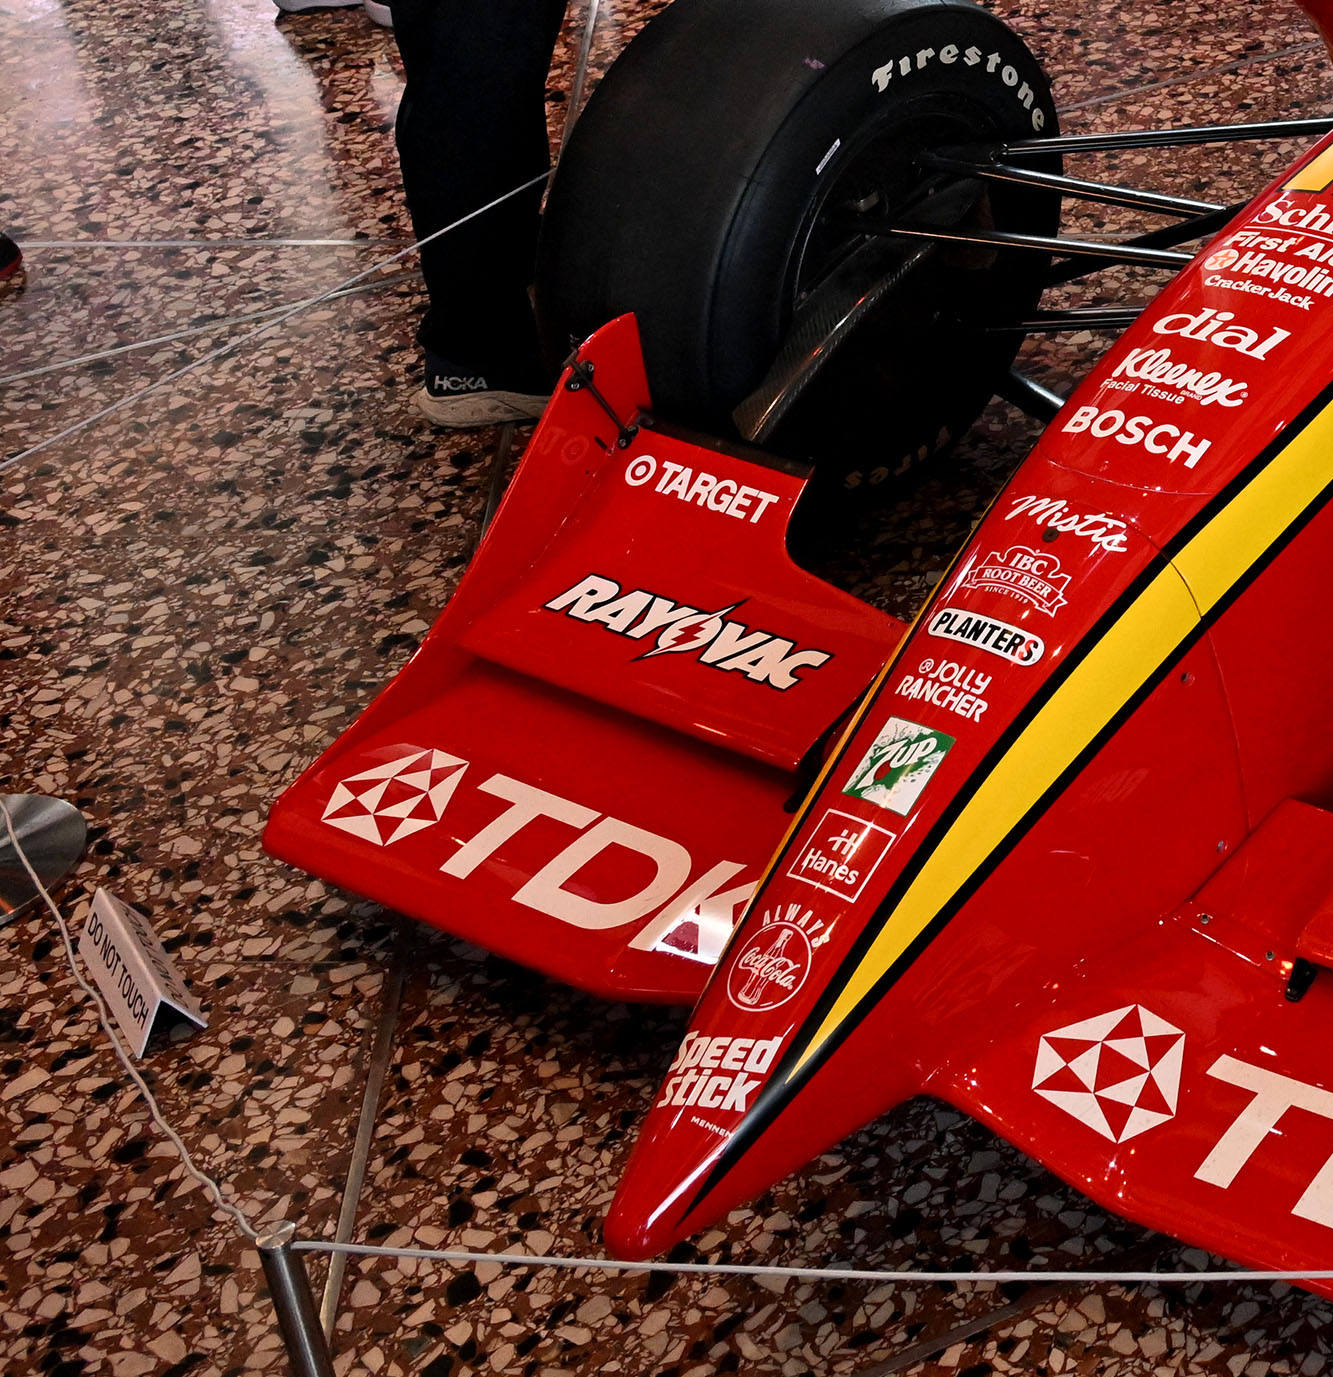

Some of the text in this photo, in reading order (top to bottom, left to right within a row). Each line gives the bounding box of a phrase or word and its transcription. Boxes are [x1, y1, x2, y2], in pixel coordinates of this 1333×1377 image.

[872, 44, 1045, 132] Firestone
[1223, 230, 1297, 252] First
[1152, 306, 1293, 362] dial
[433, 374, 488, 392] HOKA
[1100, 378, 1187, 405] Facial Tissue
[1111, 347, 1248, 408] Kleenex
[1061, 406, 1213, 470] BOSCH
[655, 461, 779, 524] TARGET
[1004, 492, 1129, 556] Mistic
[982, 567, 1053, 599] ROOT BEER
[1009, 550, 1050, 574] IBC
[984, 585, 1010, 599] SINCE
[546, 572, 834, 692] RAYOVAC
[932, 611, 1041, 664] PLANTERS
[895, 675, 988, 724] RANCHER
[933, 660, 992, 694] JOLLY
[860, 736, 938, 790] 7UP
[439, 774, 760, 966] TDK
[801, 847, 860, 886] Hanes
[762, 903, 831, 949] ALWAYS
[88, 912, 150, 1030] DO NOT TOUCH
[691, 1114, 736, 1139] MENNEN
